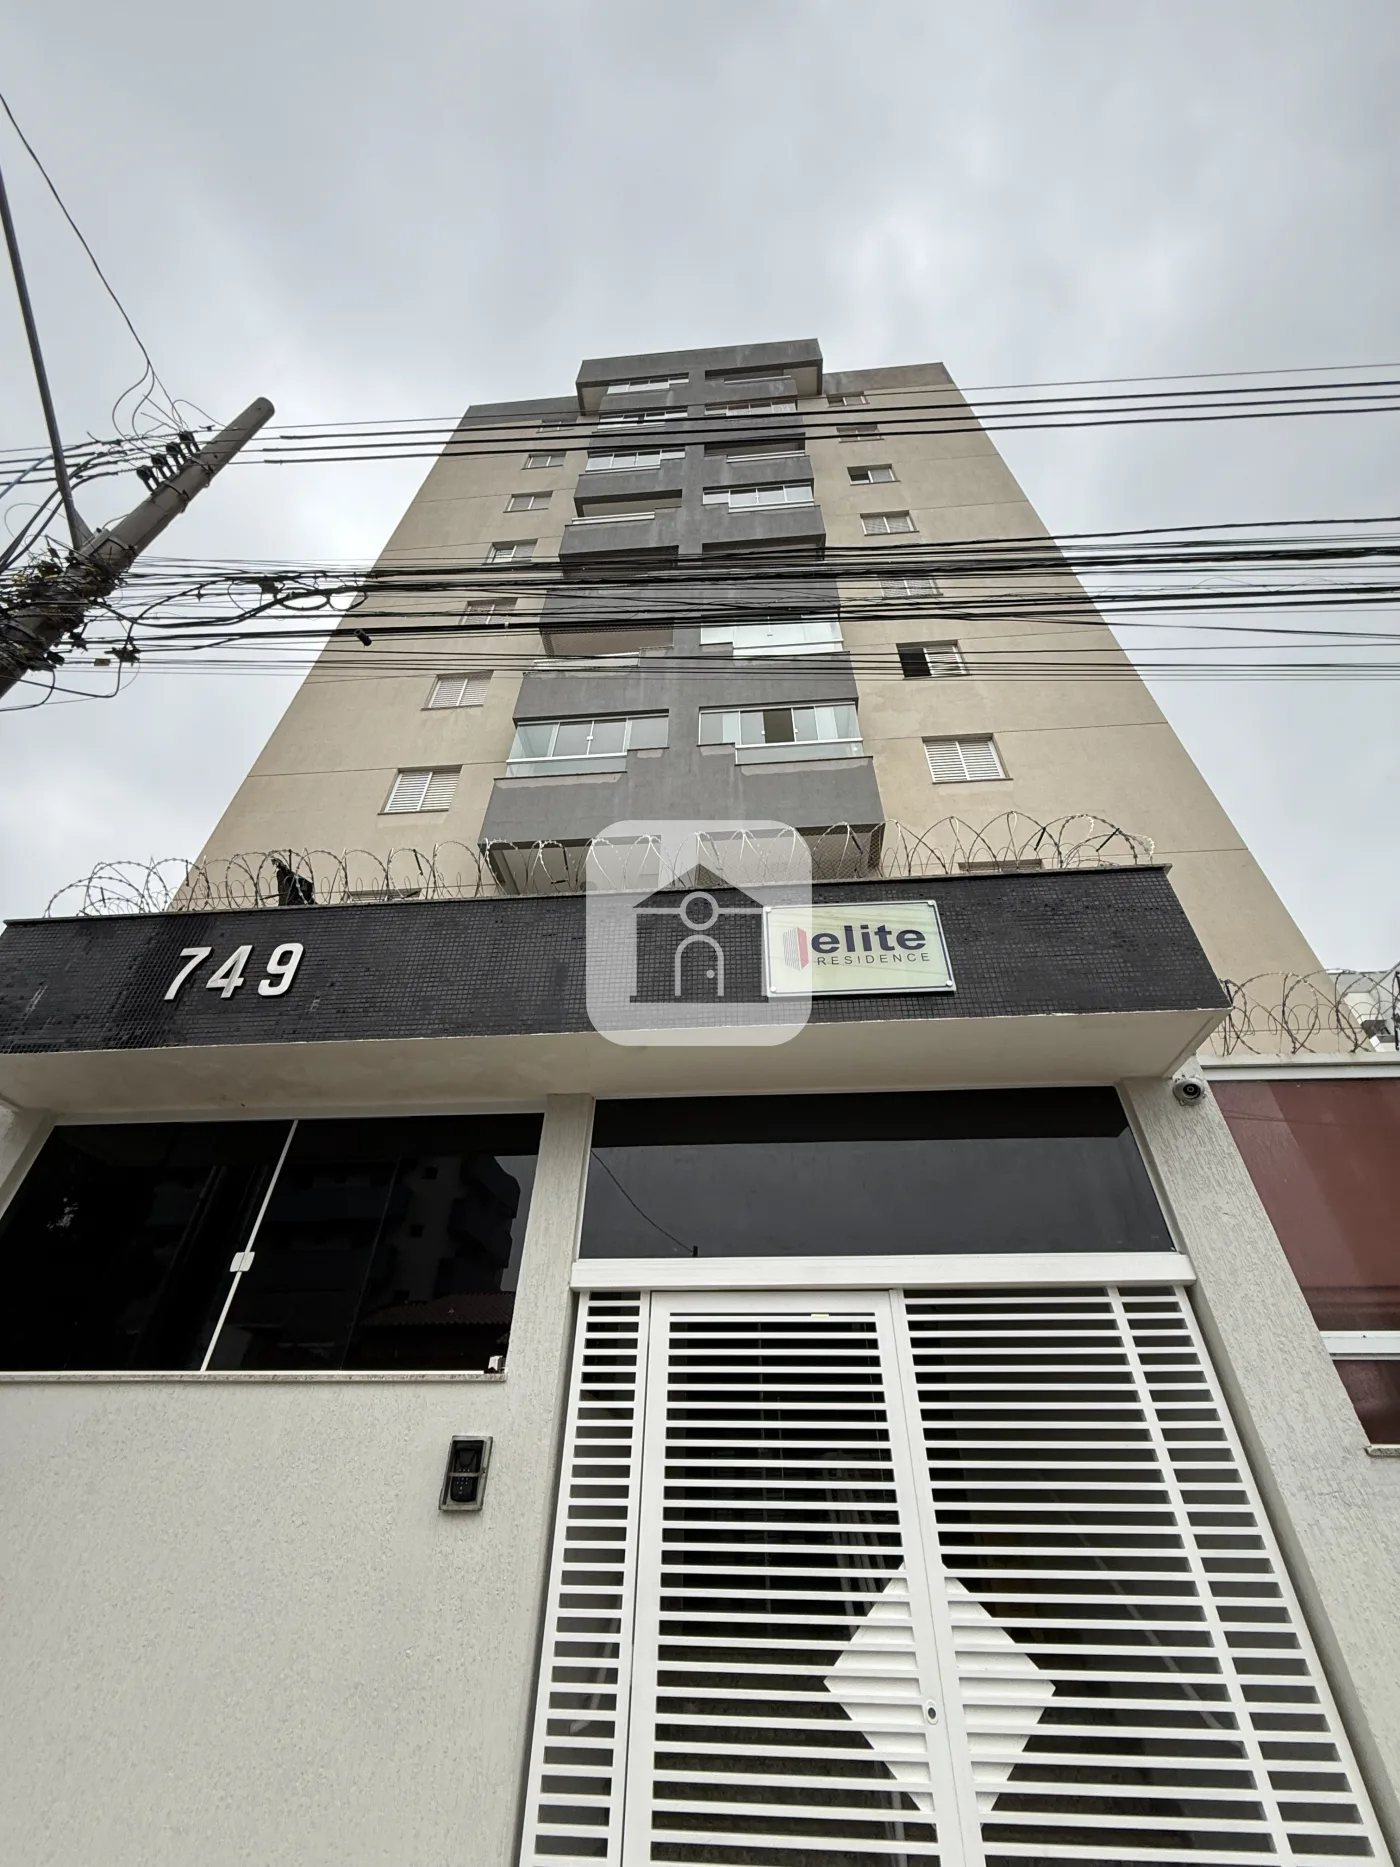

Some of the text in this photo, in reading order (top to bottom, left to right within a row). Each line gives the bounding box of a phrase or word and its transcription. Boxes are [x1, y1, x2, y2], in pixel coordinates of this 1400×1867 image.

[811, 924, 926, 954] elite
[164, 942, 304, 1000] 749
[817, 952, 930, 965] RESIDENCE
